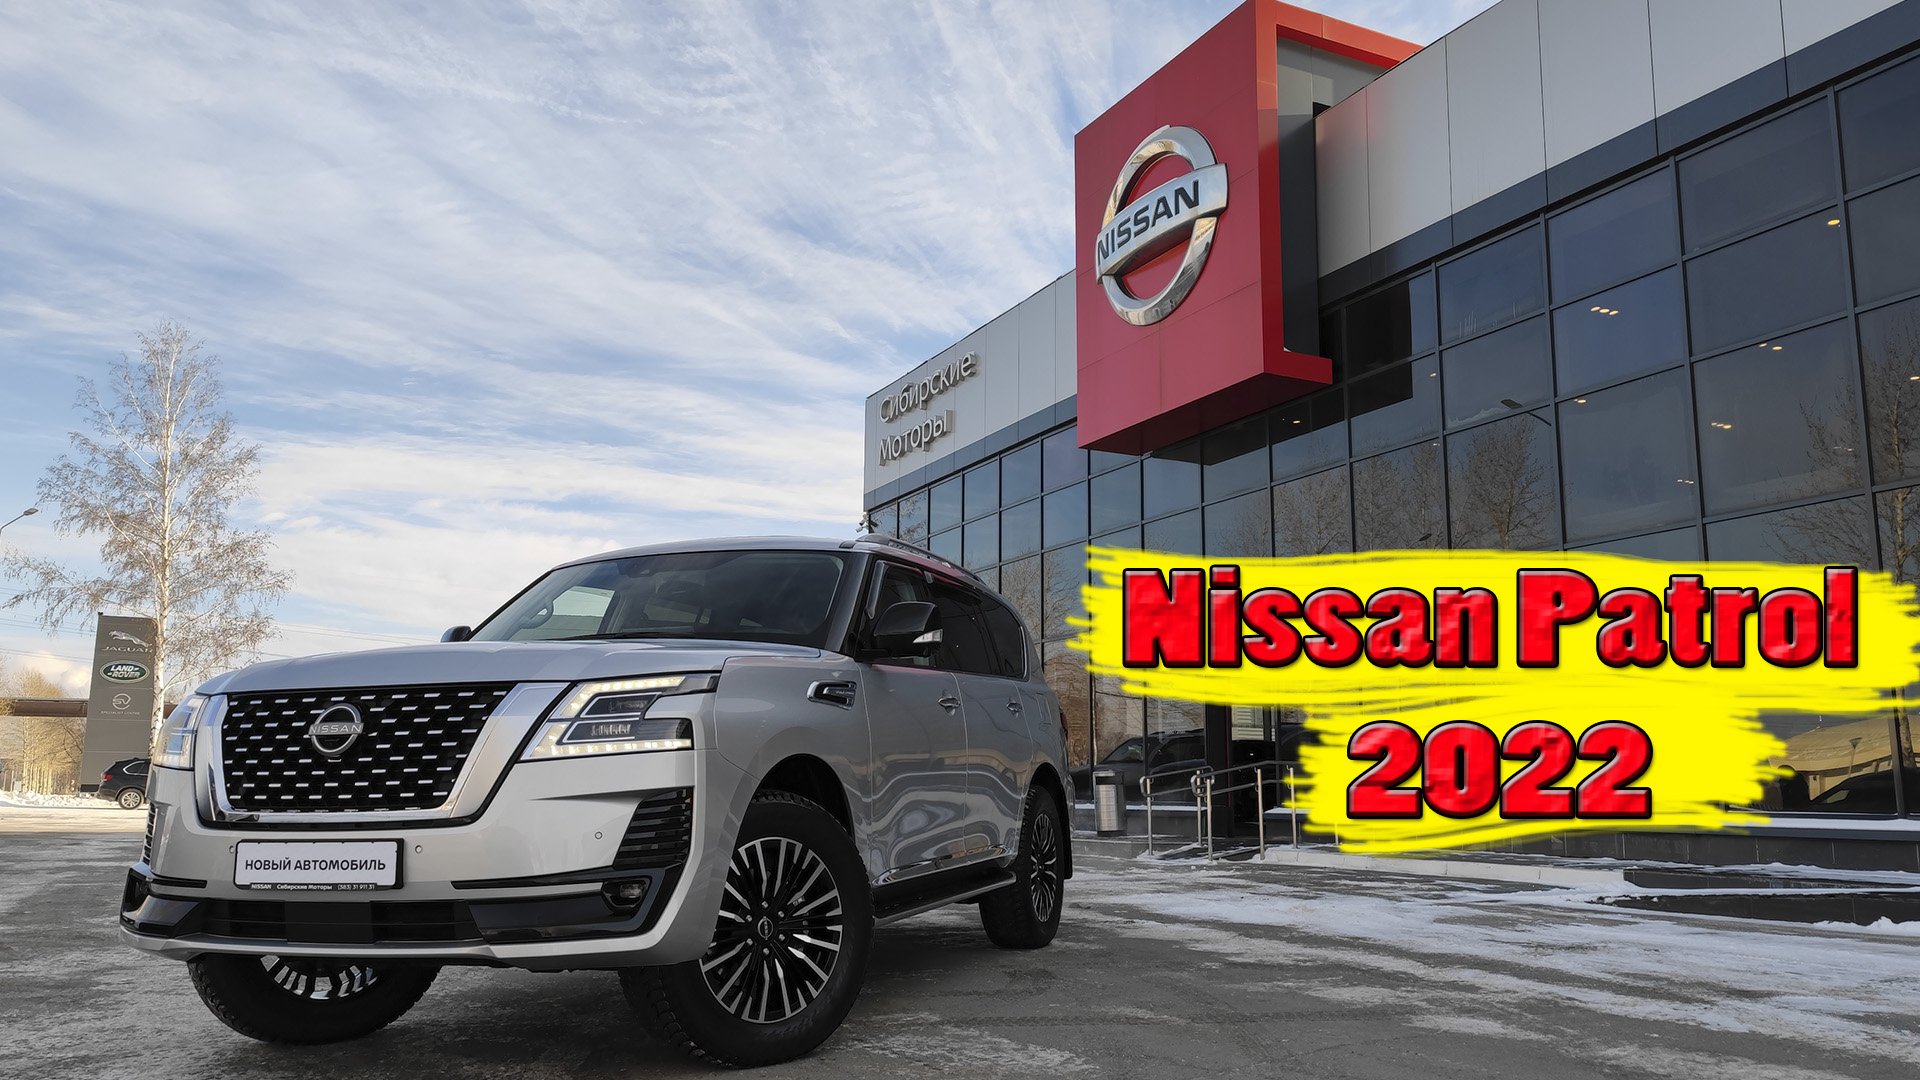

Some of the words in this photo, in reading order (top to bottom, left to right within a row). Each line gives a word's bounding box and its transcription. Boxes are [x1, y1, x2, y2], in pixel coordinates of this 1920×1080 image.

[1098, 179, 1199, 266] NISSAN
[880, 351, 977, 423] Сибирские
[879, 409, 953, 466] Моторы
[310, 724, 362, 733] NISSAN
[245, 857, 291, 870] НОВЫЙ
[294, 859, 386, 870] АВТОМОБИЛЬ
